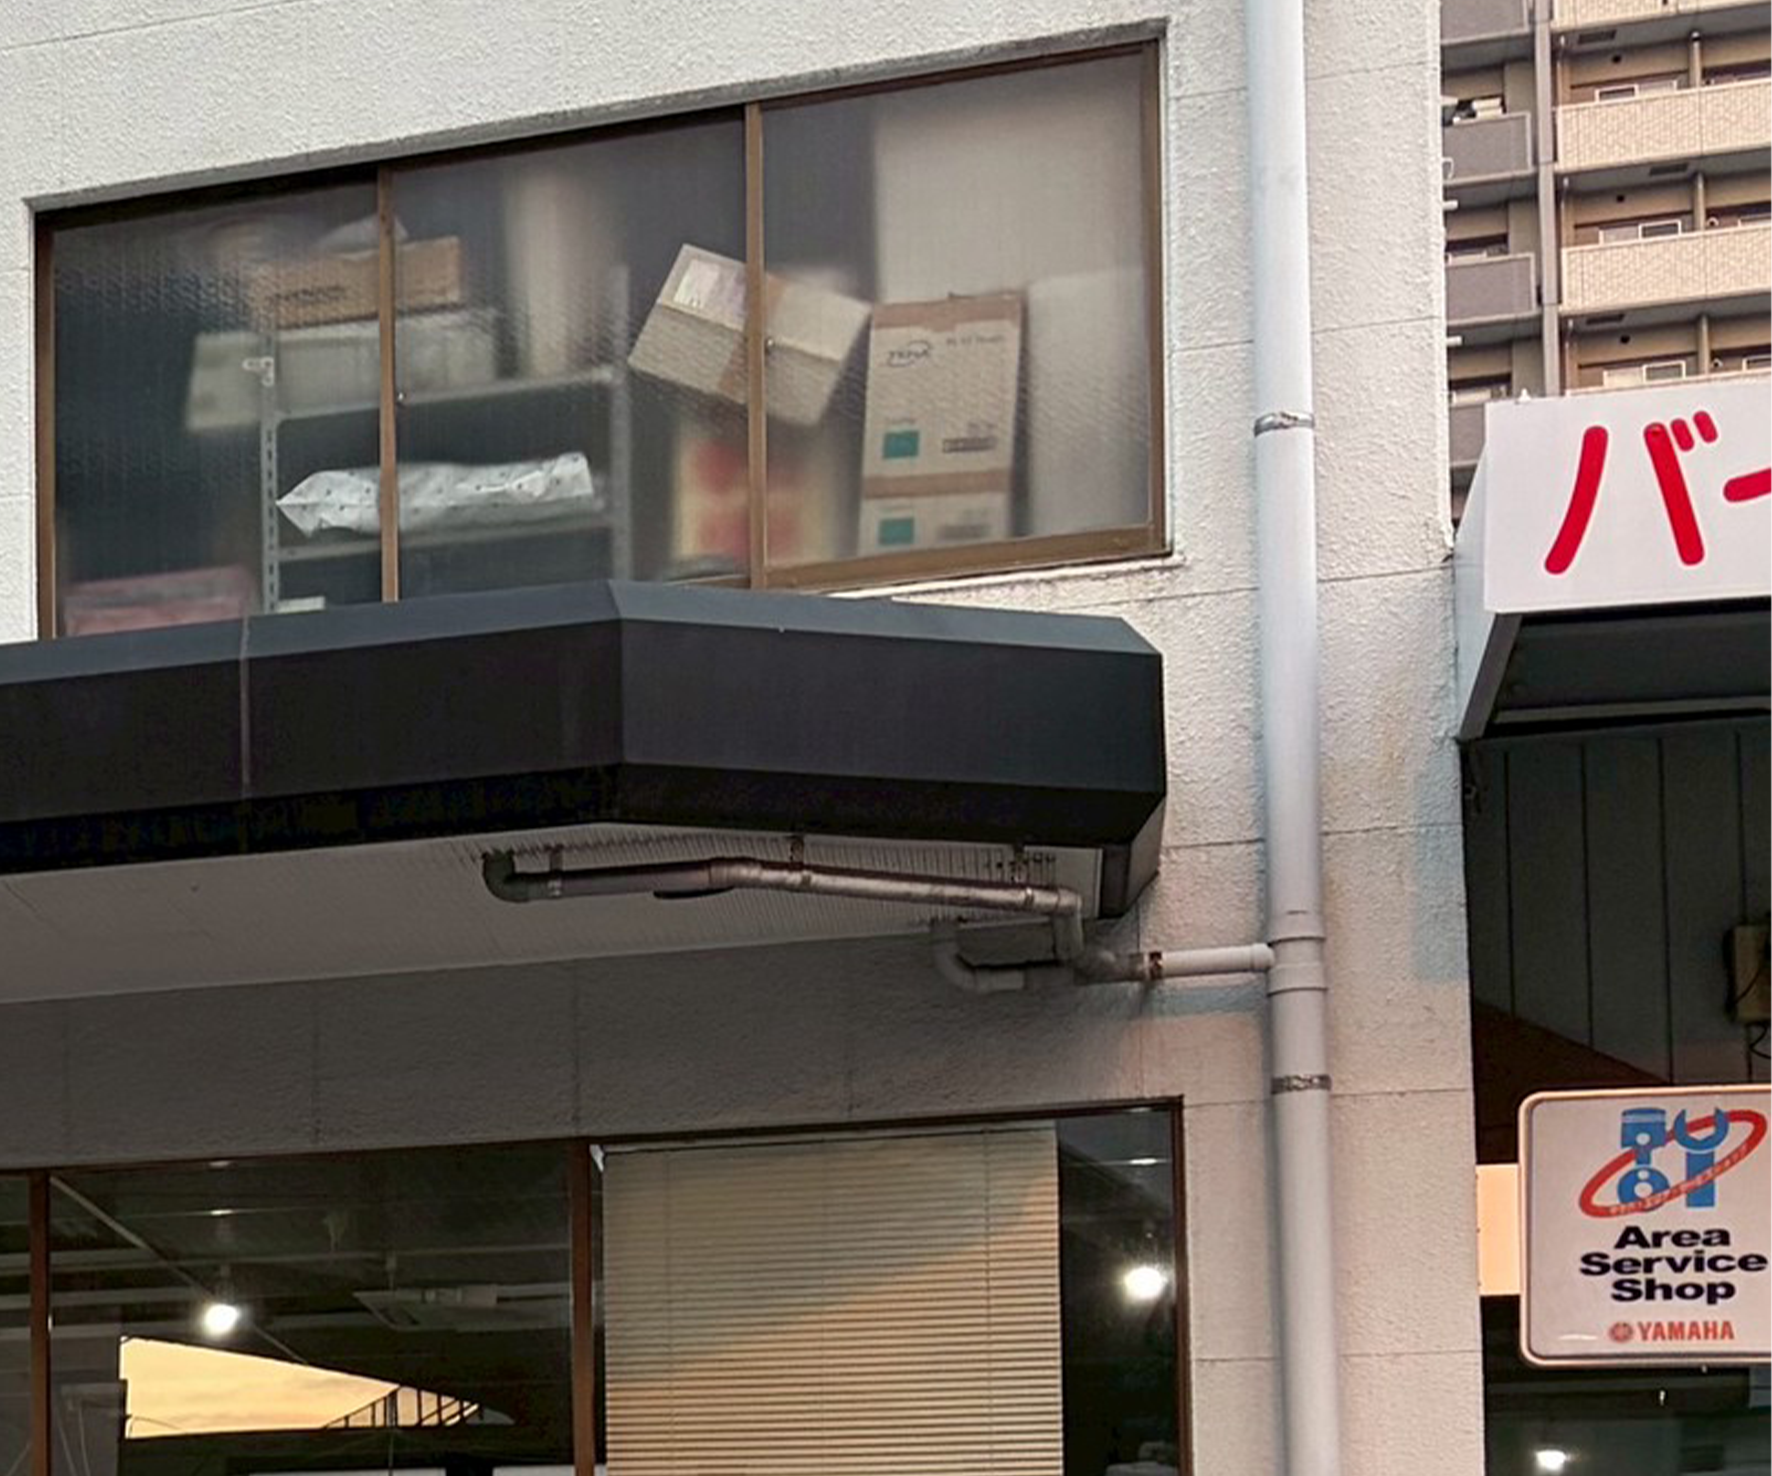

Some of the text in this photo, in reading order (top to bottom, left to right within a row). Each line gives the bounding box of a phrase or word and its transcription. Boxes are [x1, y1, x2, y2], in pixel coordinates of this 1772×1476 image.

[1544, 410, 1772, 577] バ
[1614, 1225, 1732, 1250] Area
[1579, 1250, 1769, 1277] Service
[1611, 1278, 1736, 1305] Shop
[1637, 1320, 1735, 1341] YAMAHA
